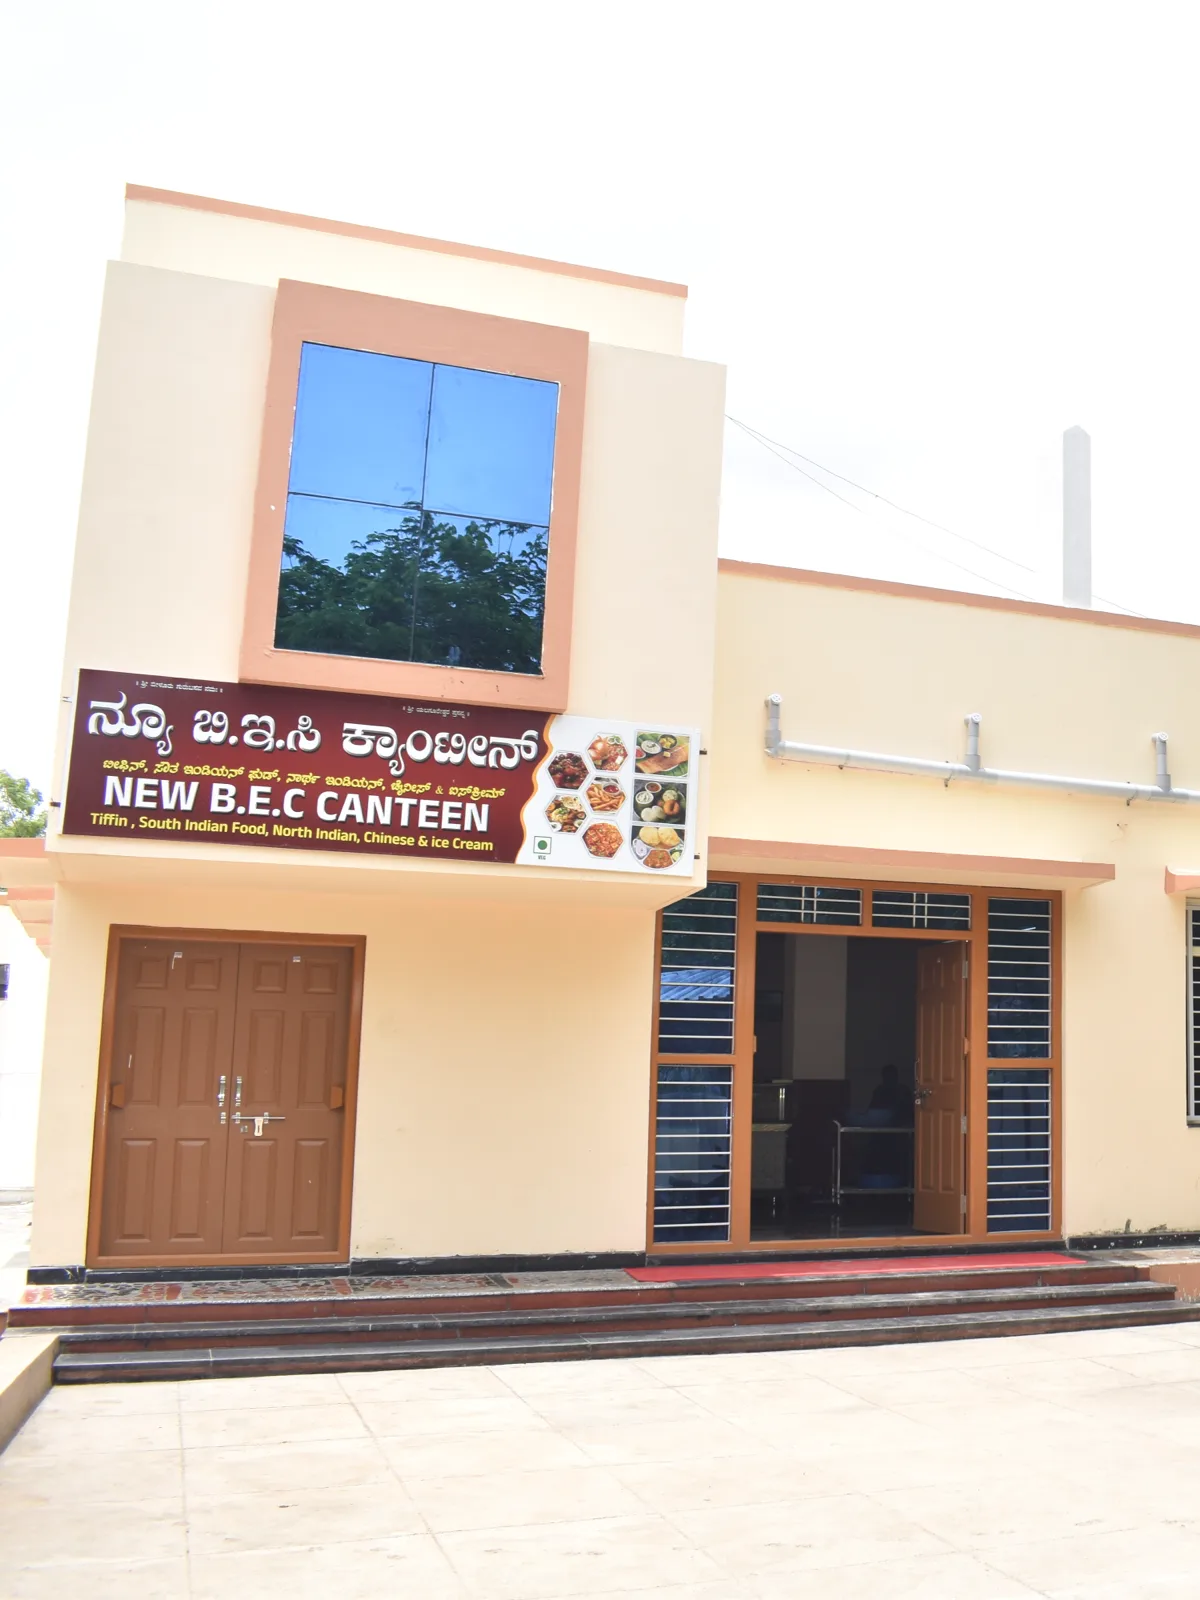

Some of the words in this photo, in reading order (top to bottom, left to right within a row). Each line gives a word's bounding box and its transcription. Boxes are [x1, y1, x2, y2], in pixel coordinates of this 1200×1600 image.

[87, 691, 174, 756] ನ್ಯೂ
[342, 722, 539, 777] ಕ್ಯಾಂಟೀನ್
[104, 775, 199, 812] NEW
[210, 782, 306, 819] B.E.C
[316, 790, 490, 833] CANTEEN
[435, 786, 444, 795] &
[90, 812, 128, 827] Tiffin
[139, 816, 181, 831] South
[185, 819, 228, 834] Indian
[232, 821, 269, 837] Food,
[273, 824, 312, 839] North
[316, 828, 360, 844] Indian,
[364, 831, 415, 846] Chinese
[418, 836, 428, 847] &
[432, 837, 450, 848] ice
[453, 838, 493, 851] Cream
